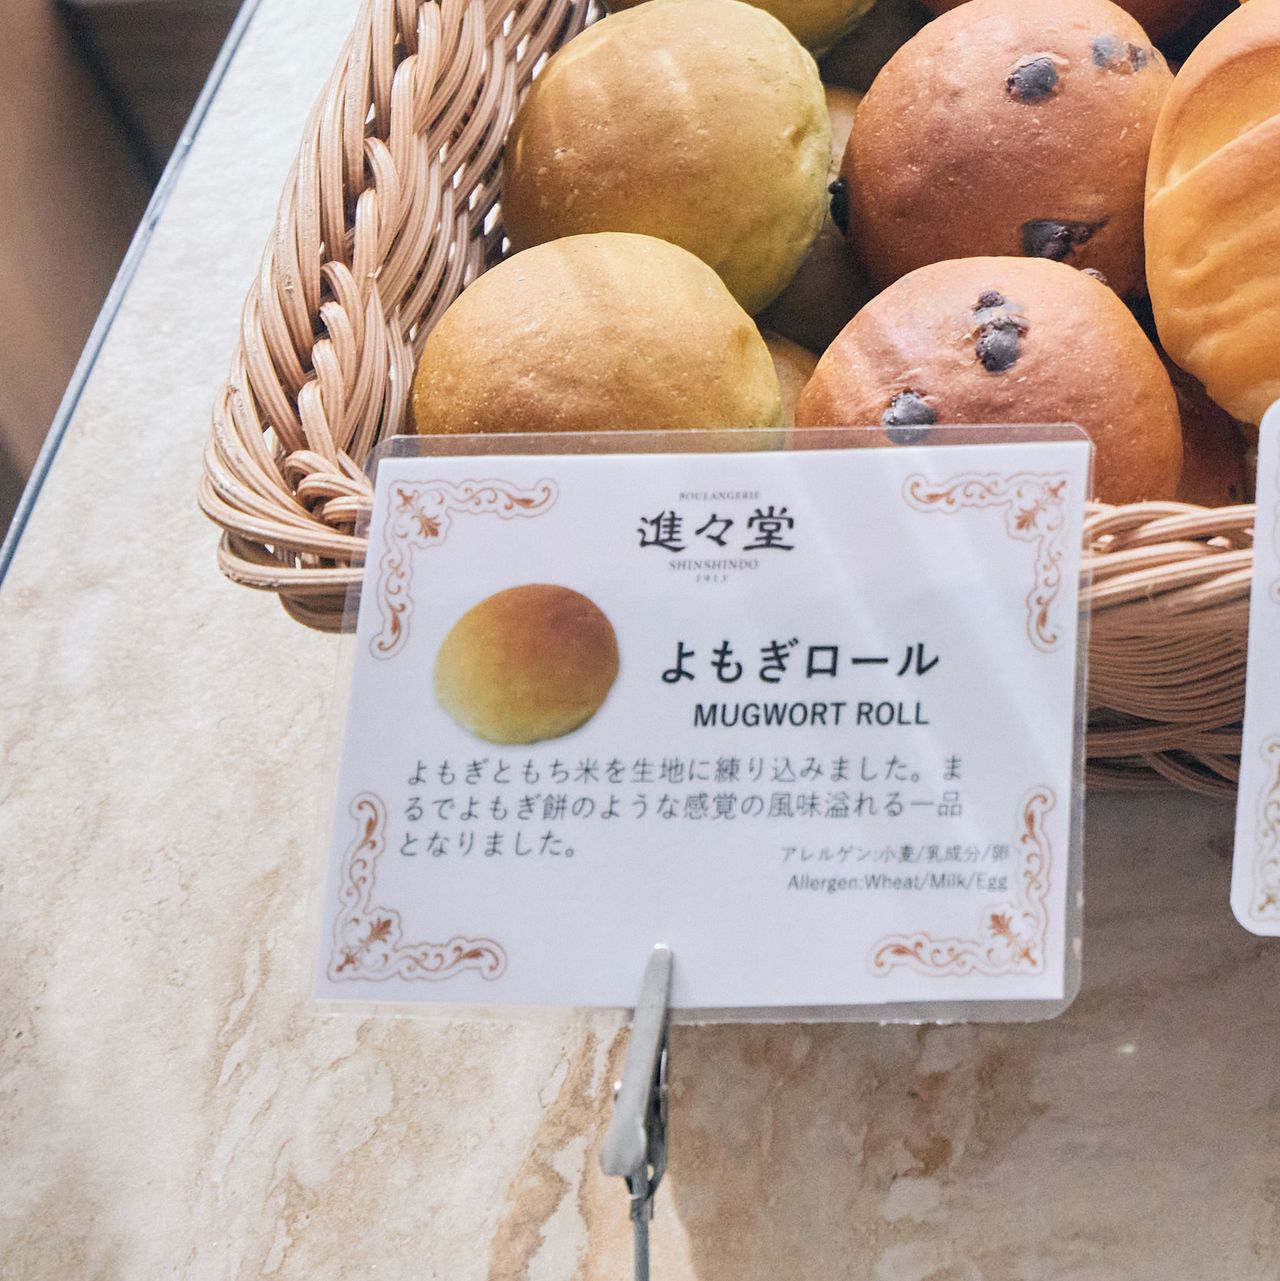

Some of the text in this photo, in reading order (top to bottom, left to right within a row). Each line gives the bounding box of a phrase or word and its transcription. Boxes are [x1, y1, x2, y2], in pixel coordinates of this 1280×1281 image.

[637, 505, 795, 554] 進々堂
[669, 559, 759, 571] SHINSHINDO
[661, 637, 940, 685] よもぎロール
[693, 700, 930, 728] MUGWORT ROLL
[399, 829, 575, 858] となりました。
